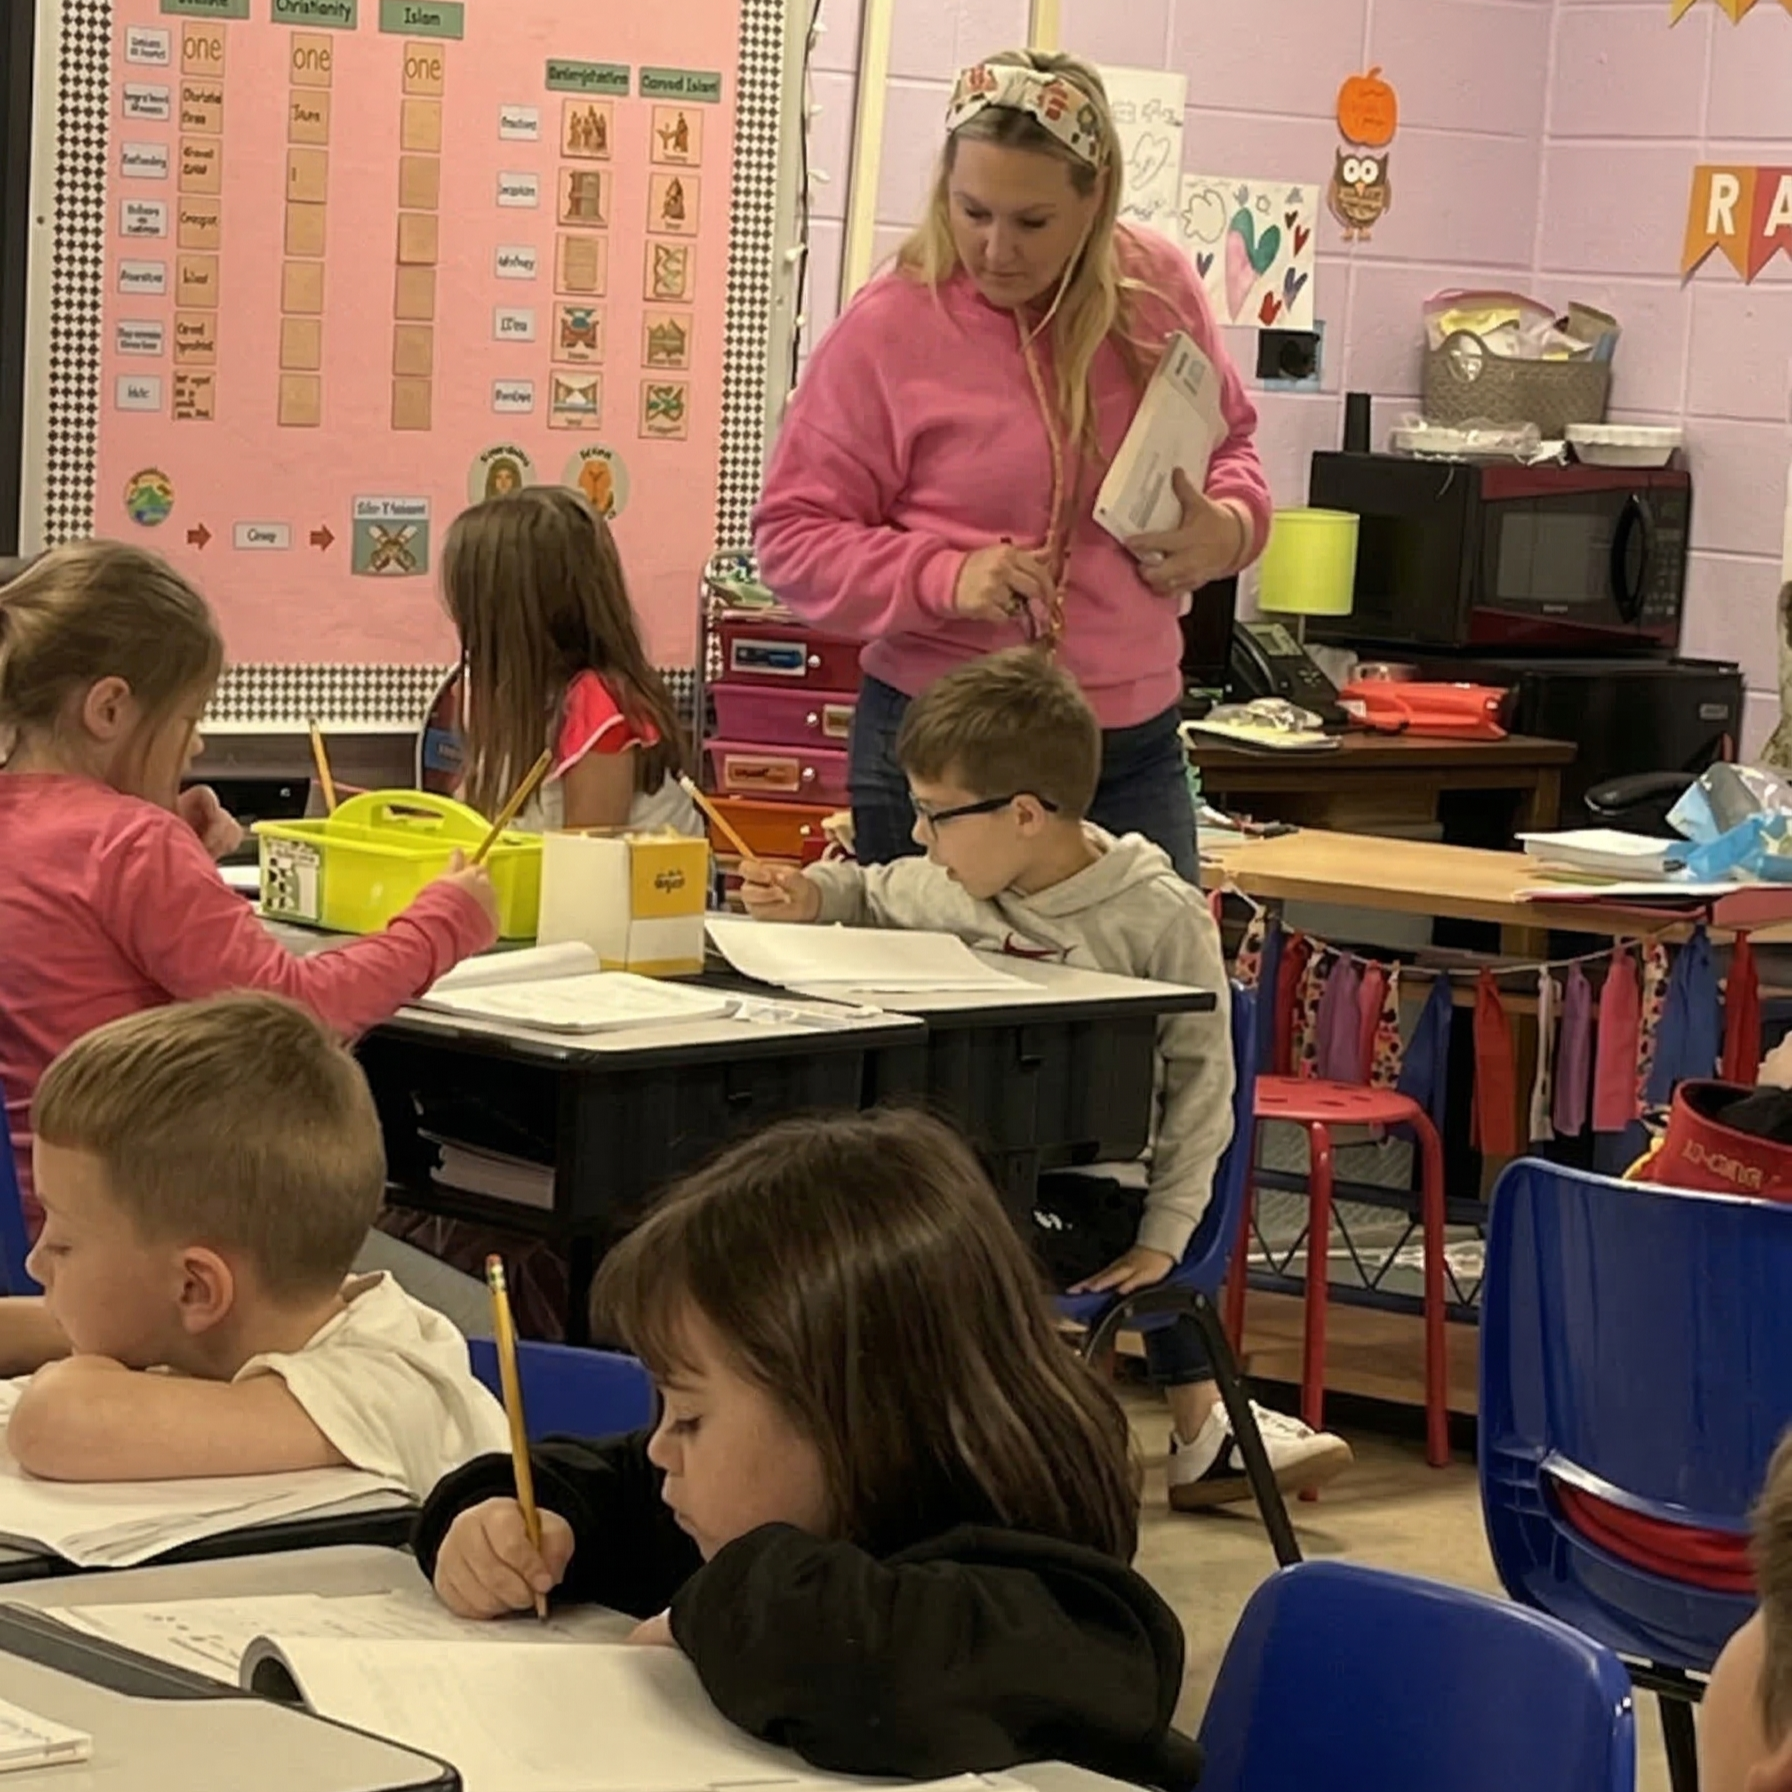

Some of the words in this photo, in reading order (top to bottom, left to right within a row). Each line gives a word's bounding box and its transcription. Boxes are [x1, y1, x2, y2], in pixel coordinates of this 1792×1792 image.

[276, 0, 351, 22] Christianity
[404, 7, 441, 27] Islam
[183, 36, 222, 61] one
[292, 47, 332, 72] one
[404, 56, 442, 82] one
